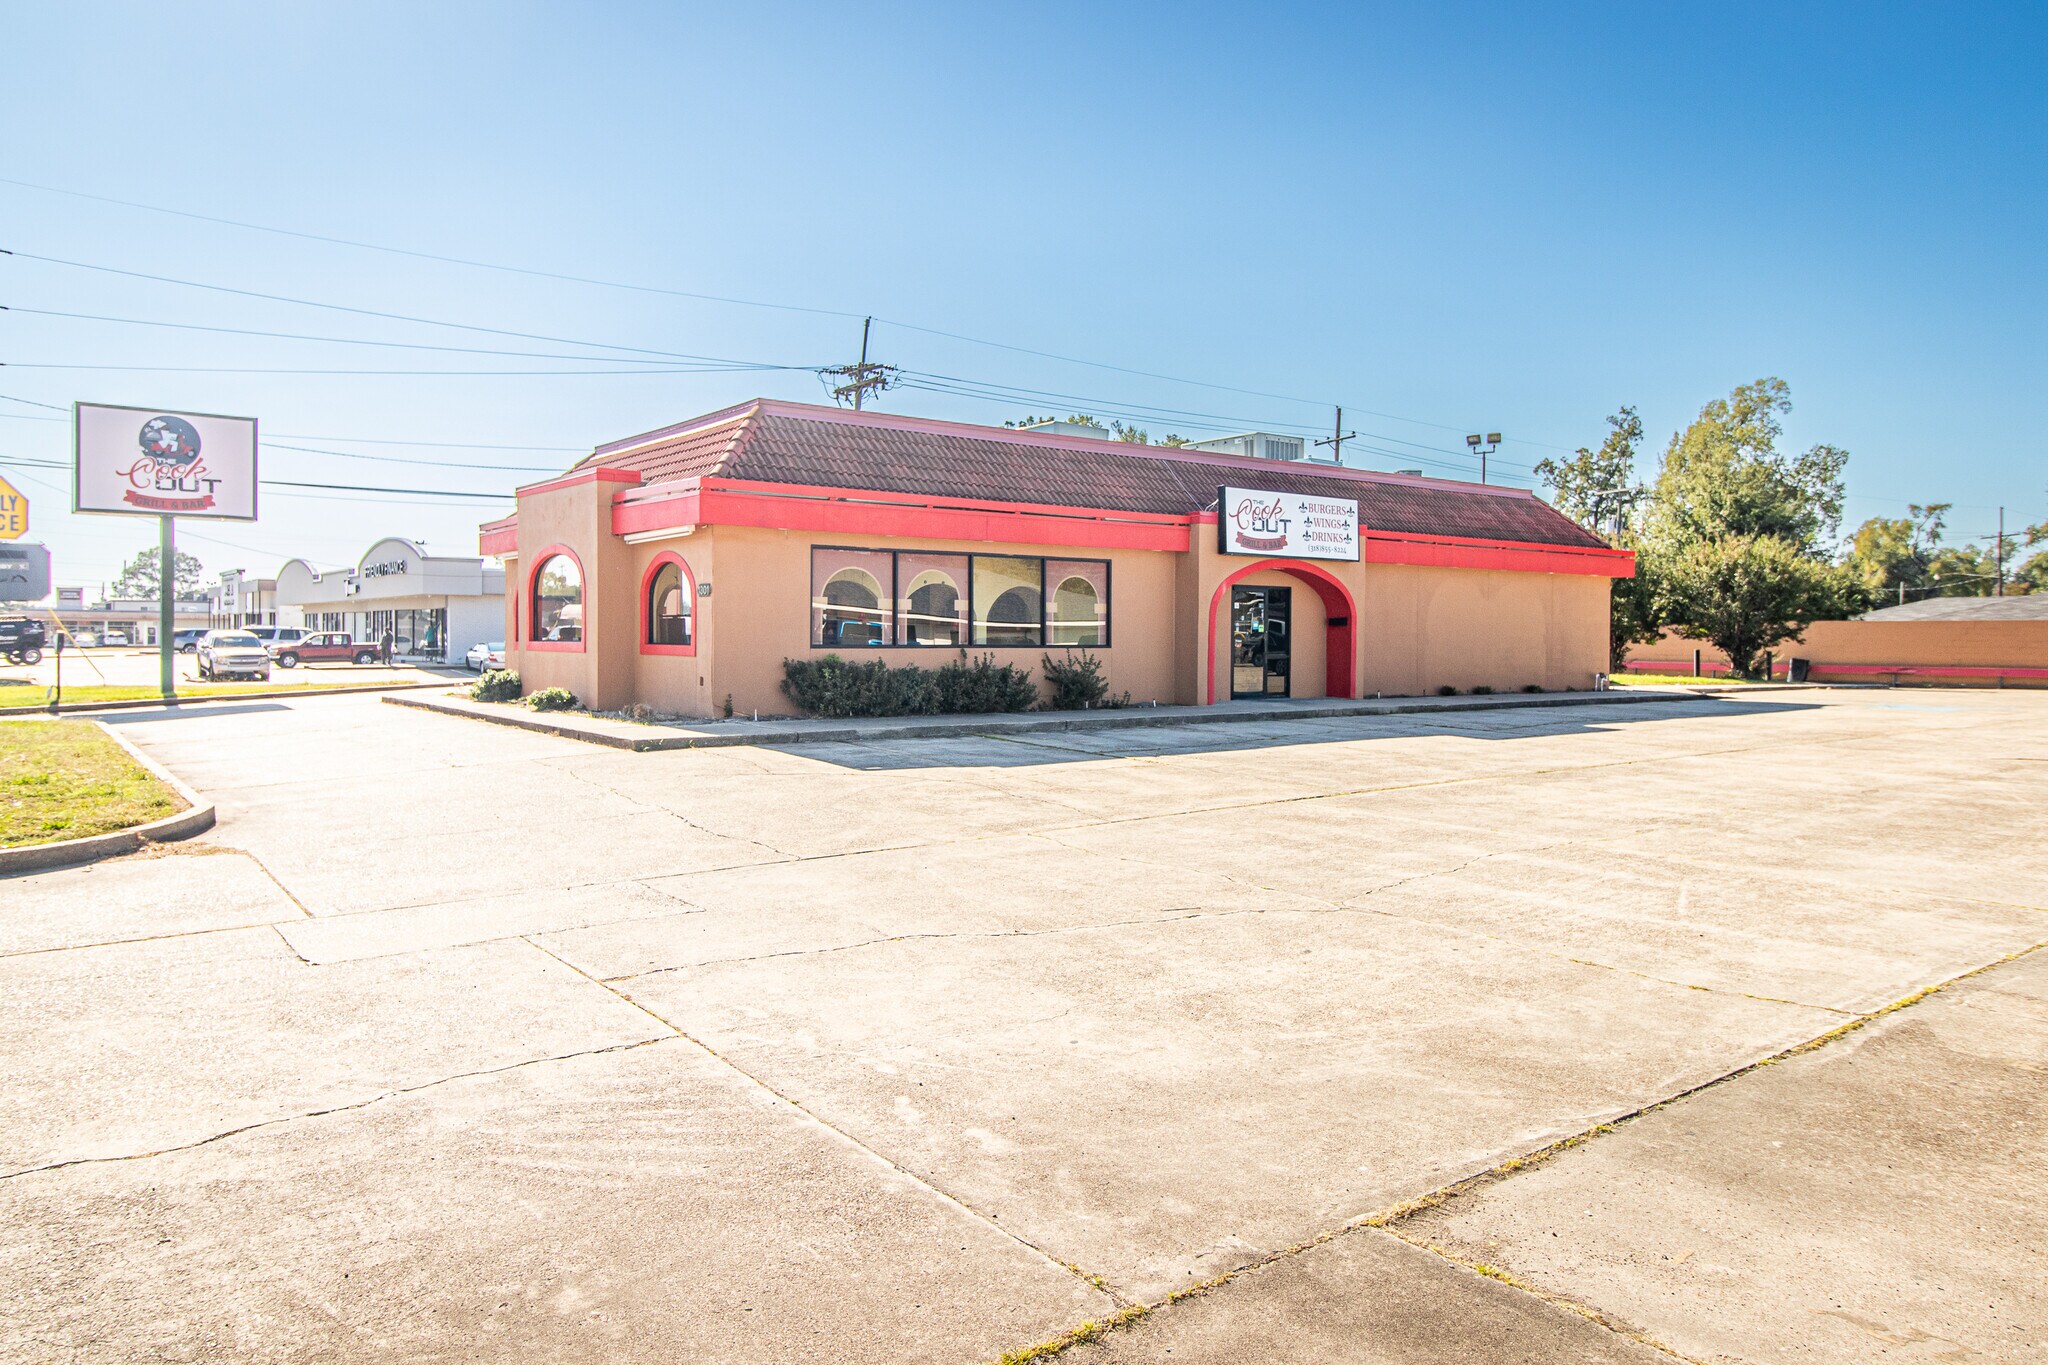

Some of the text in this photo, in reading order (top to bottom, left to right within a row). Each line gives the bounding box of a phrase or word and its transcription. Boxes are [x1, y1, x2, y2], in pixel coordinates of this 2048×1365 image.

[116, 457, 212, 489] Cook
[156, 475, 222, 493] OUT
[135, 496, 166, 509] GRILL
[181, 500, 205, 509] BAR
[1229, 498, 1285, 530] Cook
[1308, 503, 1347, 516] BURGERS
[1252, 517, 1292, 533] OUT
[1313, 517, 1342, 529] WINGS
[1242, 538, 1260, 548] GRILL
[1269, 540, 1281, 548] BAR
[1312, 531, 1344, 543] DRINKS
